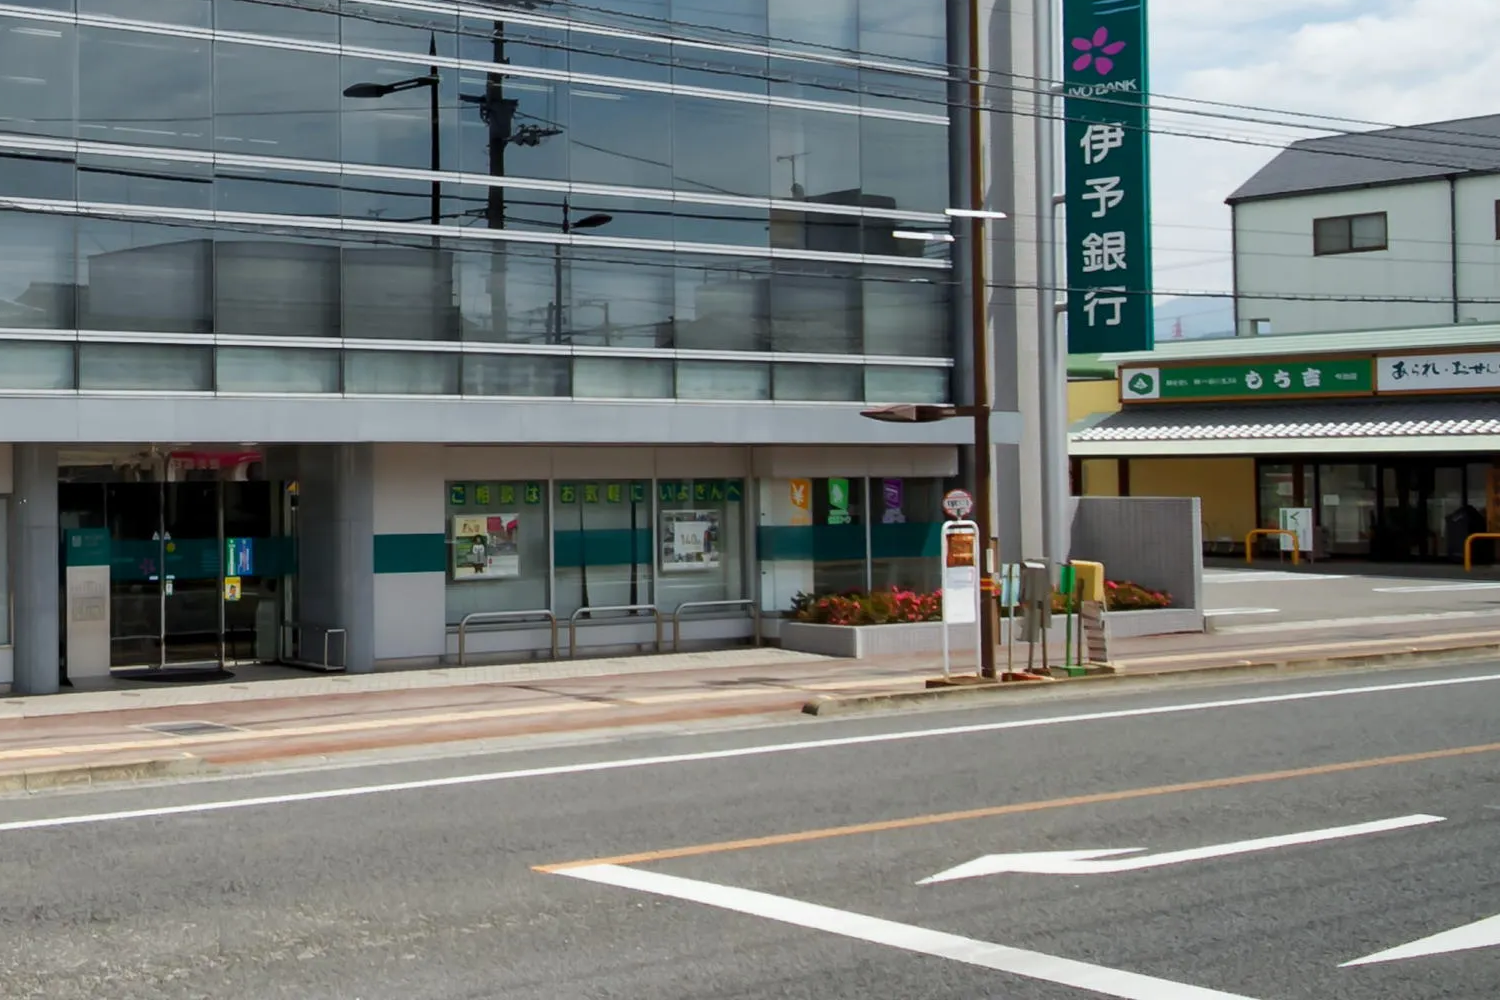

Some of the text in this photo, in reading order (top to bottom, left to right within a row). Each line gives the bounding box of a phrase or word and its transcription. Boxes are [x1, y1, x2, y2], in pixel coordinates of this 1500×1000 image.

[1079, 121, 1128, 327] 伊予銀行
[1245, 367, 1322, 390] もち吉
